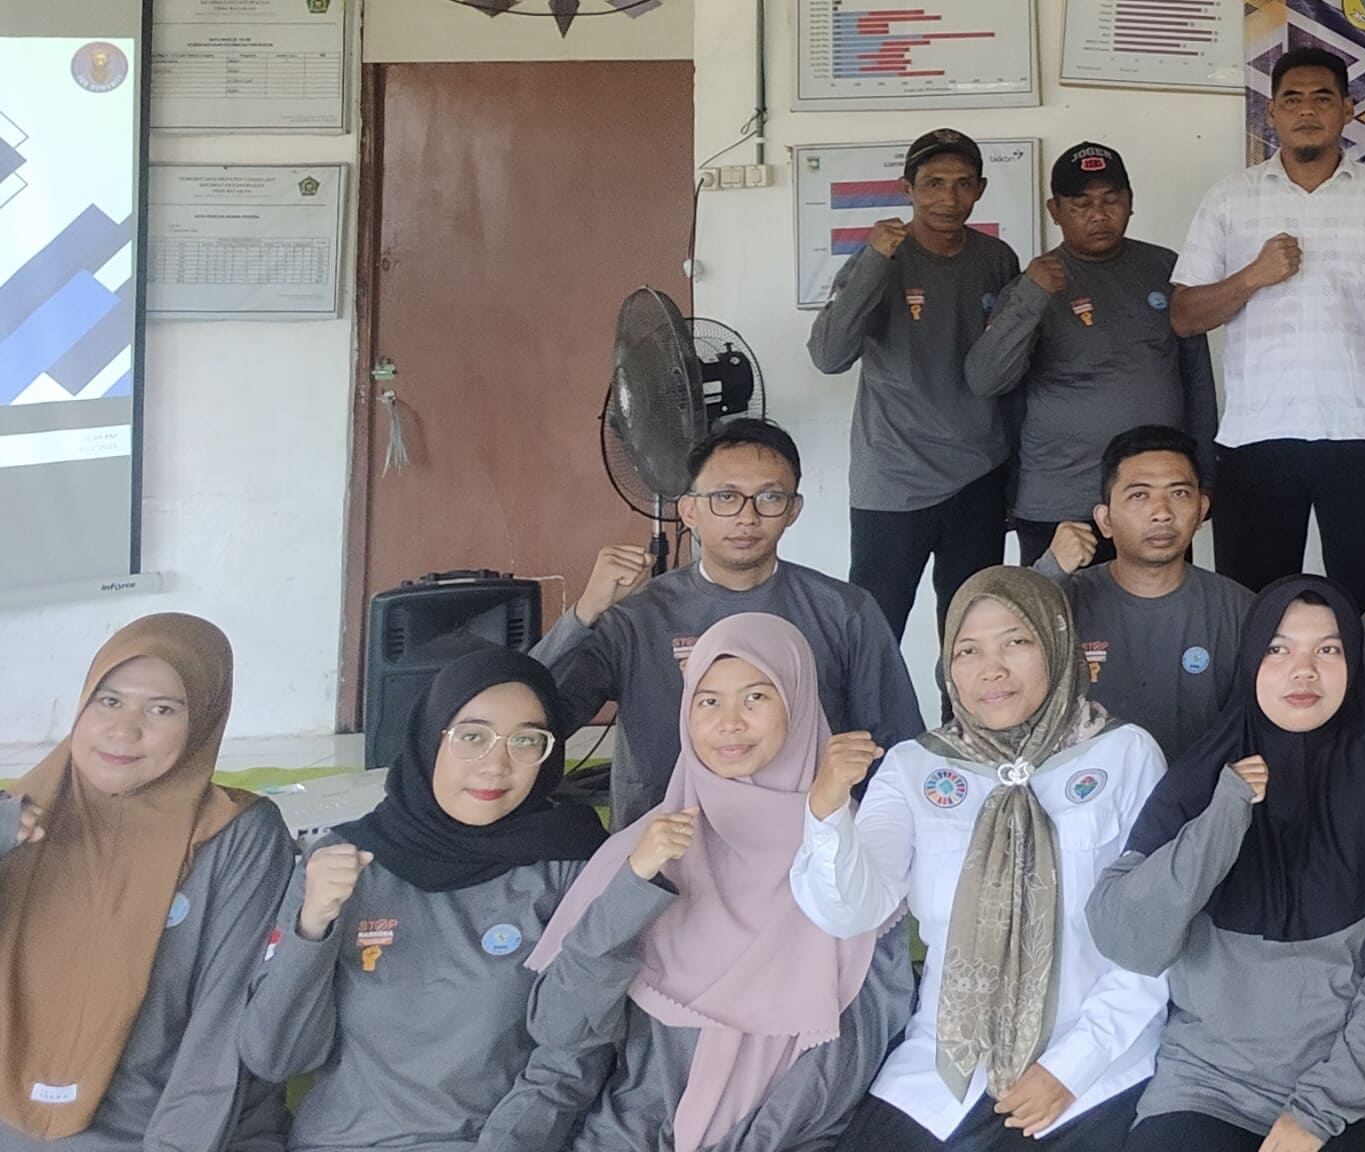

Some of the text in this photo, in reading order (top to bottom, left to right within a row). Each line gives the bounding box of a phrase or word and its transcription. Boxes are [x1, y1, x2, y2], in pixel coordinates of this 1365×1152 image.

[1071, 147, 1113, 163] JOGER
[672, 637, 698, 648] STO
[358, 919, 398, 932] STOP
